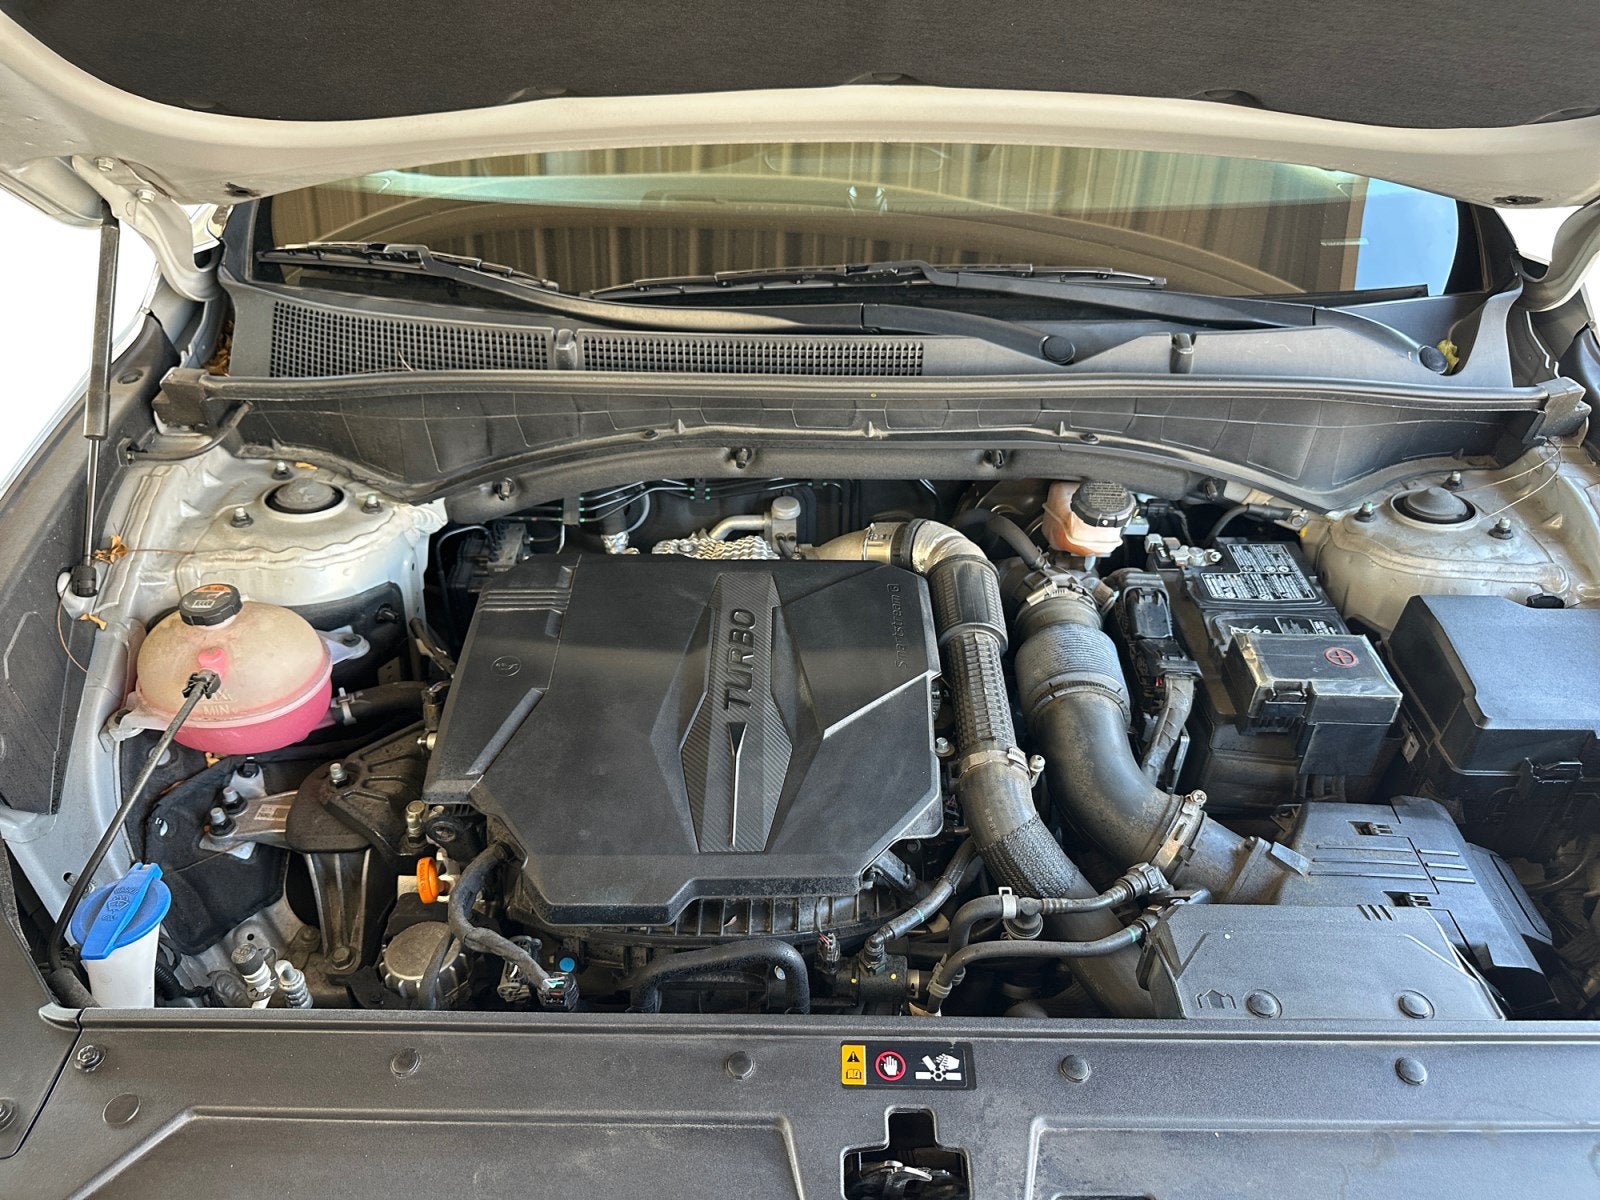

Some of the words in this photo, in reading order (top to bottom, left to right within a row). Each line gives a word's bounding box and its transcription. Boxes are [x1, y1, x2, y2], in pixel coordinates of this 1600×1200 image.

[723, 608, 756, 711] TURBO
[892, 594, 908, 671] Smartstream
[203, 704, 230, 716] MIN
